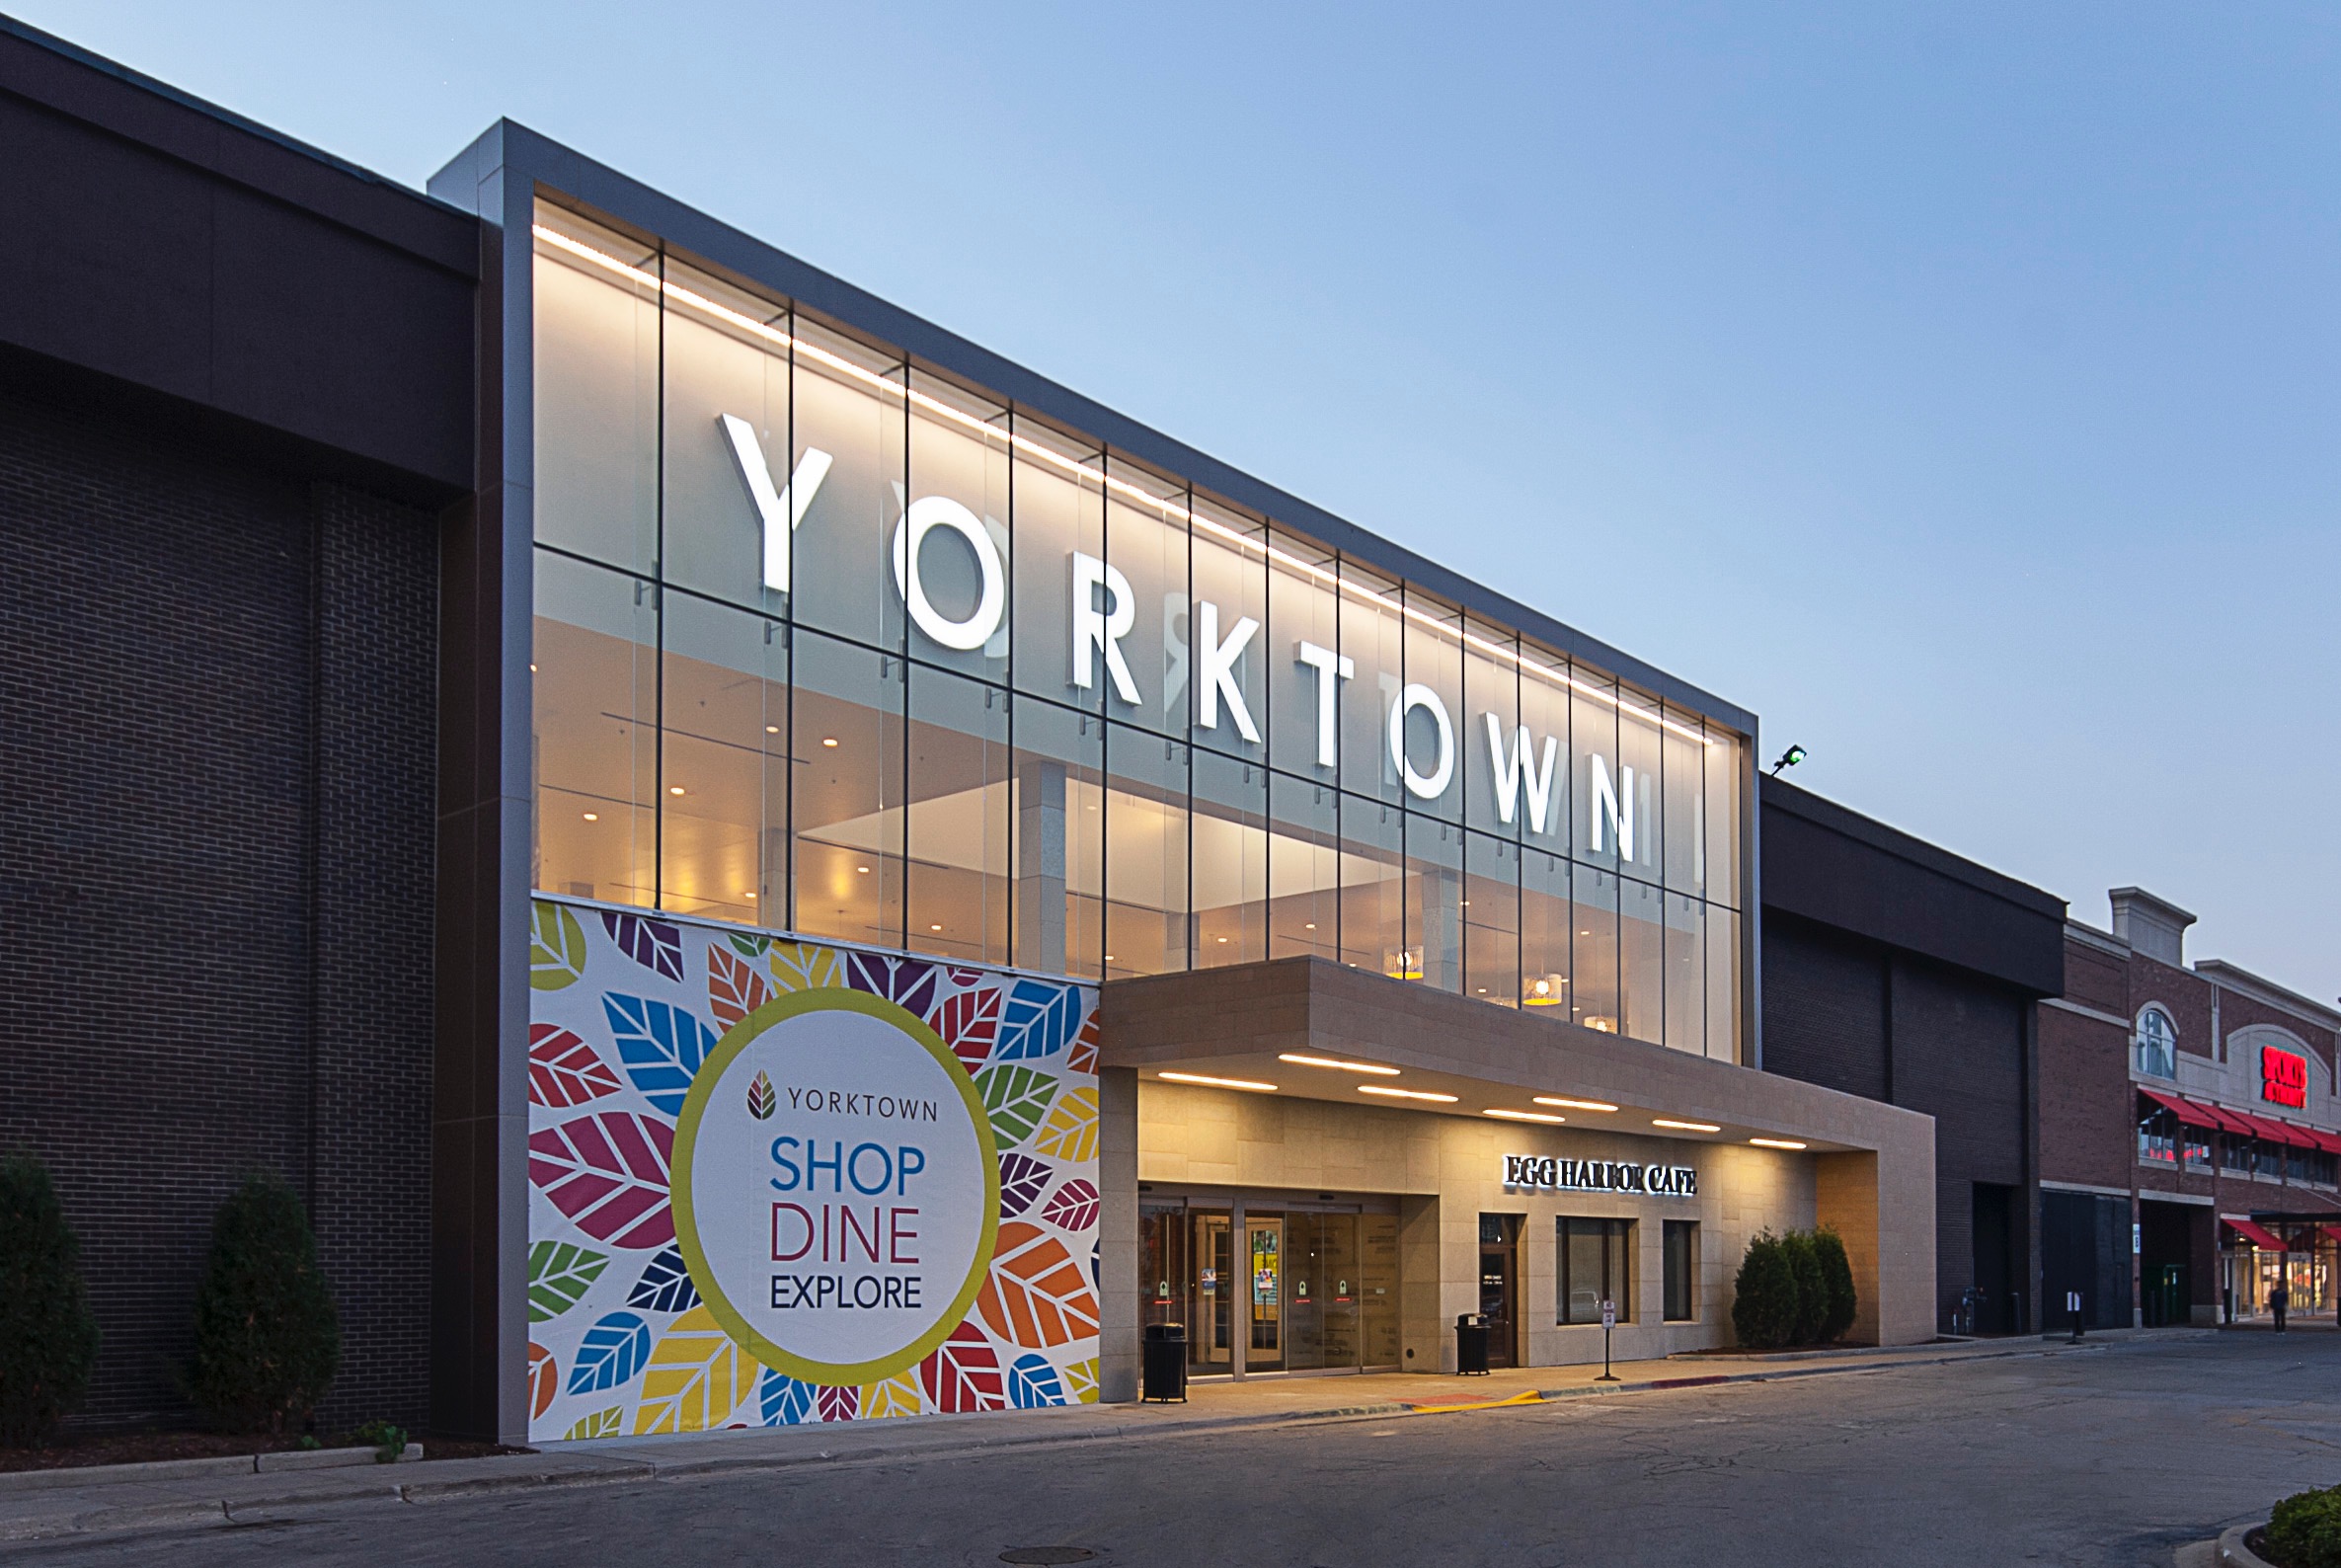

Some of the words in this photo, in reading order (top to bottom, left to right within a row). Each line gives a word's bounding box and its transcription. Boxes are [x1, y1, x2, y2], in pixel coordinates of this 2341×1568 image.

[717, 413, 1635, 862] YORKTOWN
[788, 1087, 937, 1122] YORKTOWN
[769, 1136, 925, 1197] SHOP
[1505, 1155, 1557, 1186] EGG
[1558, 1159, 1646, 1192] HARBOR
[1647, 1165, 1698, 1195] CAFE
[769, 1201, 920, 1265] DINE
[770, 1274, 922, 1310] EXPLORE
